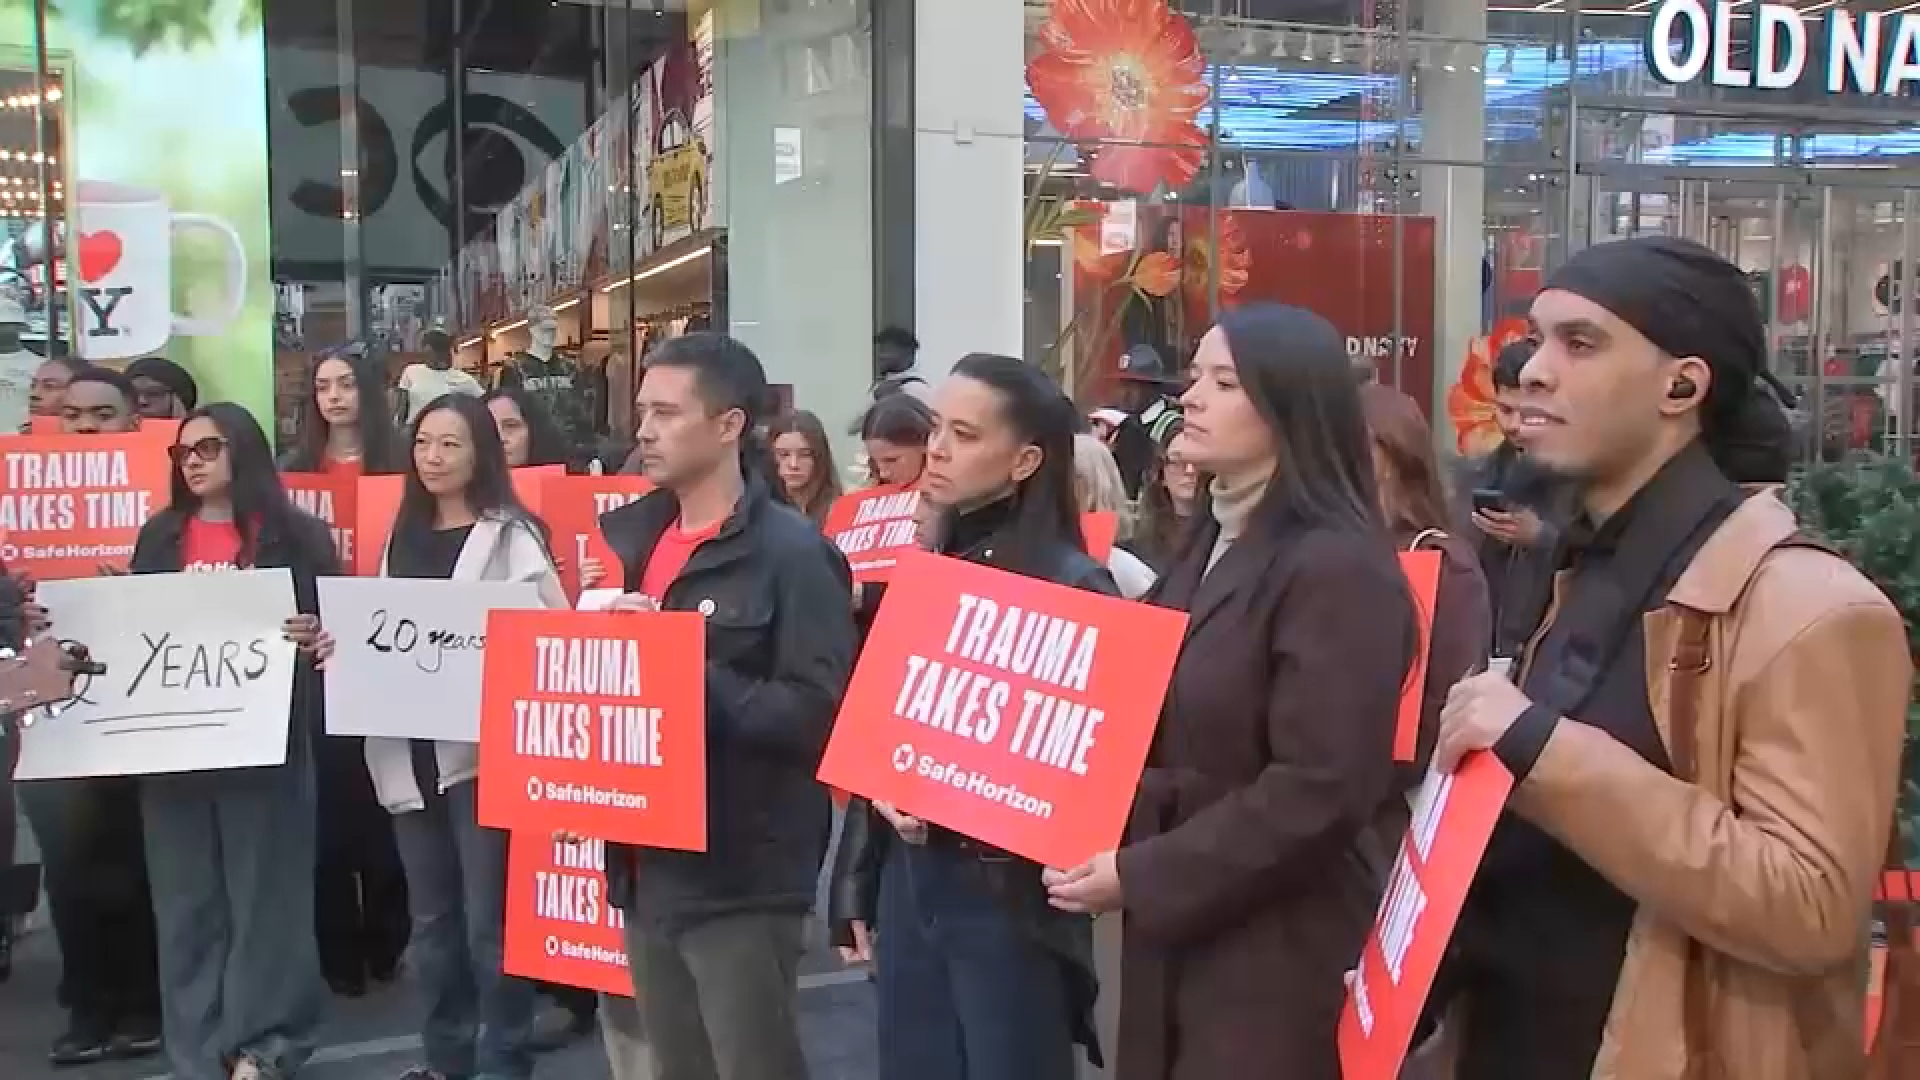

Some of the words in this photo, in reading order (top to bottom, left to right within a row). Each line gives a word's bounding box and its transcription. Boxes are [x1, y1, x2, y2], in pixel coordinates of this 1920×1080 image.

[1651, 0, 1807, 89] OLD
[5, 451, 129, 489] TRAUMA
[0, 493, 76, 531] AKES
[366, 609, 419, 653] 20
[944, 592, 1100, 692] TRAUMA
[126, 632, 269, 697] YEARS
[536, 637, 641, 697] TRAUMA
[513, 699, 591, 761] TAKES
[599, 705, 663, 767] TIME
[894, 655, 1011, 744] TAKES
[1009, 689, 1105, 776] TIME
[546, 781, 648, 809] SafeHorizon
[917, 755, 1053, 819] SafeHorizon
[536, 871, 600, 925] TAKES
